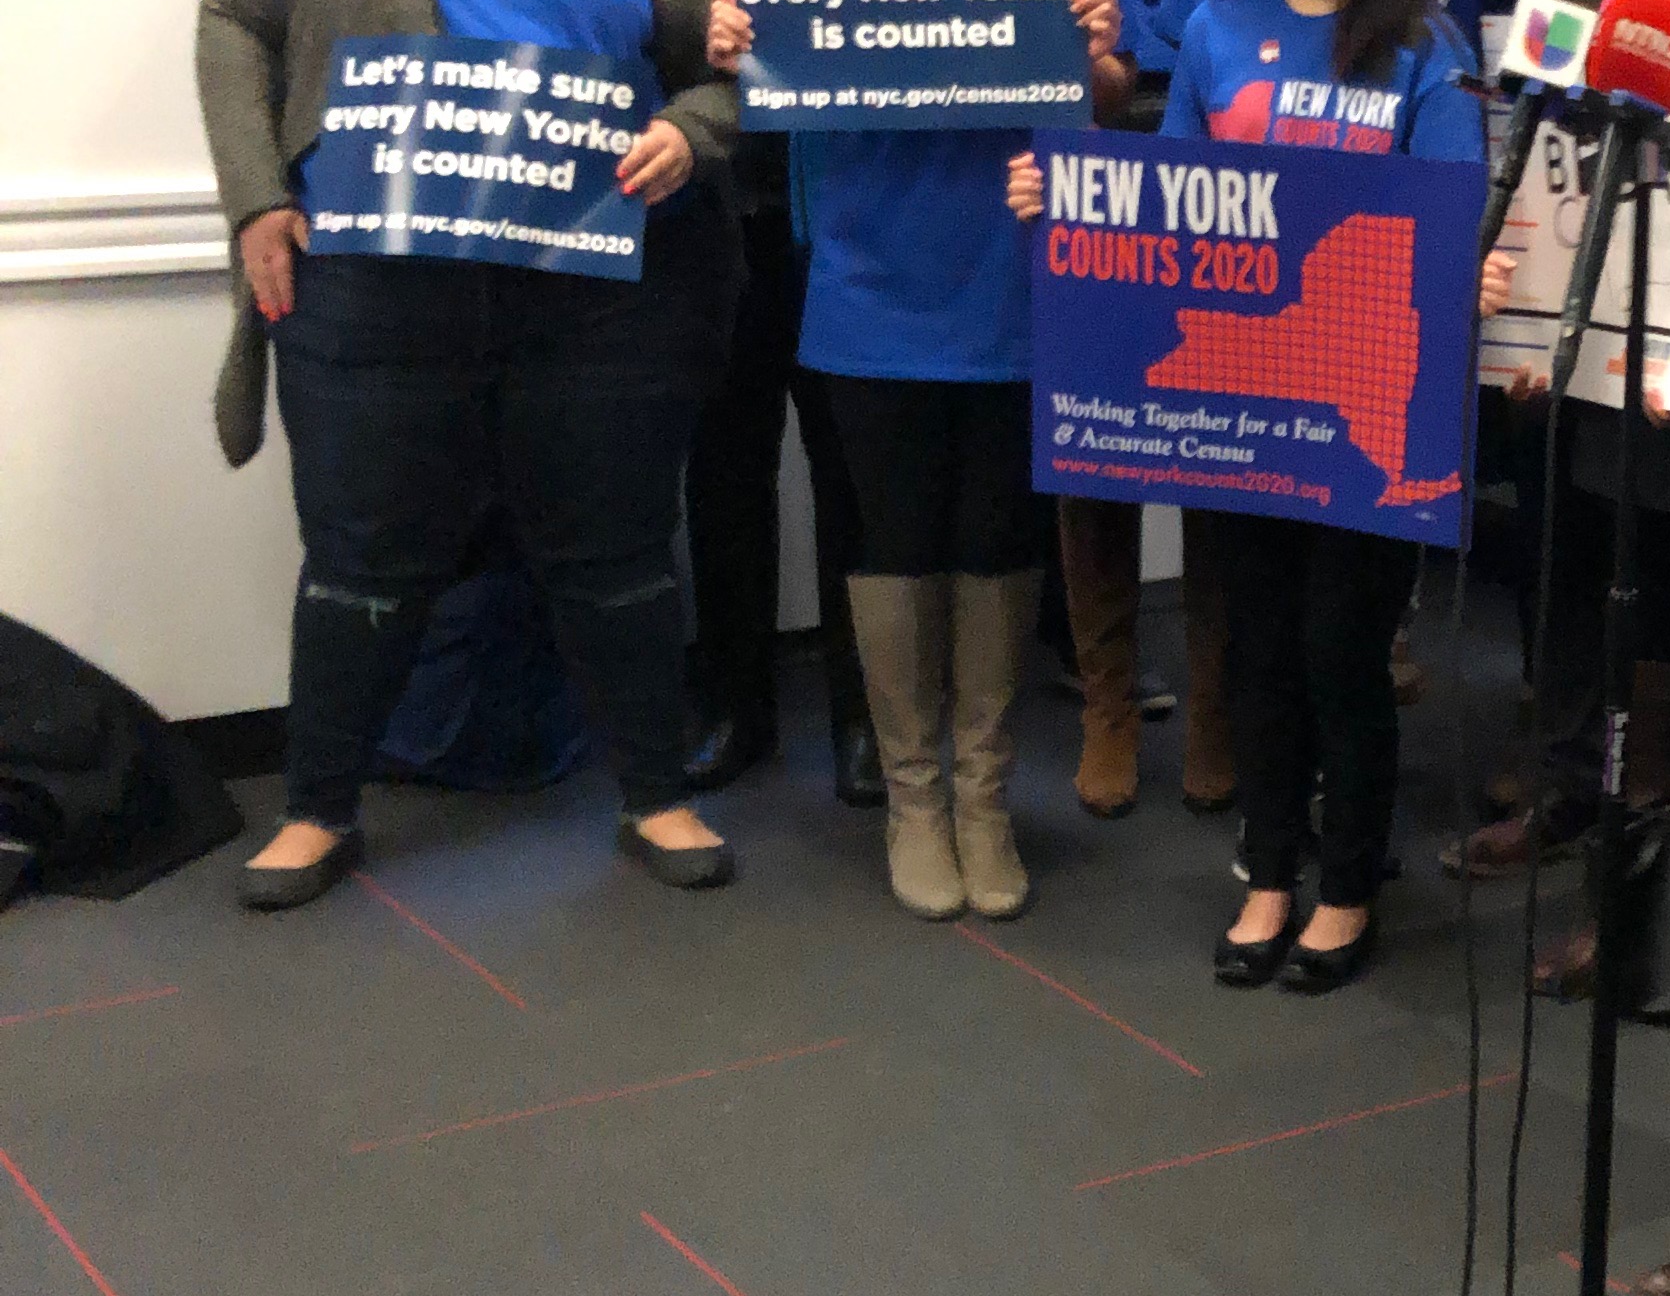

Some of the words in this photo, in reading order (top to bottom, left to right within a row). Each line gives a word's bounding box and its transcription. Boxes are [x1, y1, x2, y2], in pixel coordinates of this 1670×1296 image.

[810, 16, 845, 49] is
[854, 13, 1016, 49] counted
[343, 54, 424, 87] Let's
[432, 58, 541, 94] make
[551, 72, 635, 109] sure
[746, 88, 797, 109] Sign
[802, 89, 831, 109] up
[836, 86, 859, 105] at
[863, 83, 1084, 109] nyc.gov/census2020
[1278, 80, 1333, 118] NEW
[1334, 86, 1403, 130] YORK
[323, 105, 415, 135] every
[425, 101, 512, 137] New
[523, 110, 637, 155] Yorke
[373, 143, 403, 174] is
[412, 150, 576, 193] counted
[1049, 153, 1143, 227] NEW
[1157, 164, 1280, 239] YORK
[357, 214, 381, 233] up
[1048, 226, 1180, 287] COUNTS
[1191, 241, 1279, 295] 2020
[1053, 393, 1136, 428] Working
[1142, 402, 1230, 436] Together
[1237, 412, 1266, 439] for
[1274, 420, 1288, 438] a
[1295, 419, 1336, 446] Fair
[1053, 425, 1073, 446] &
[1079, 426, 1173, 458] Accurate
[1179, 436, 1255, 464] Census
